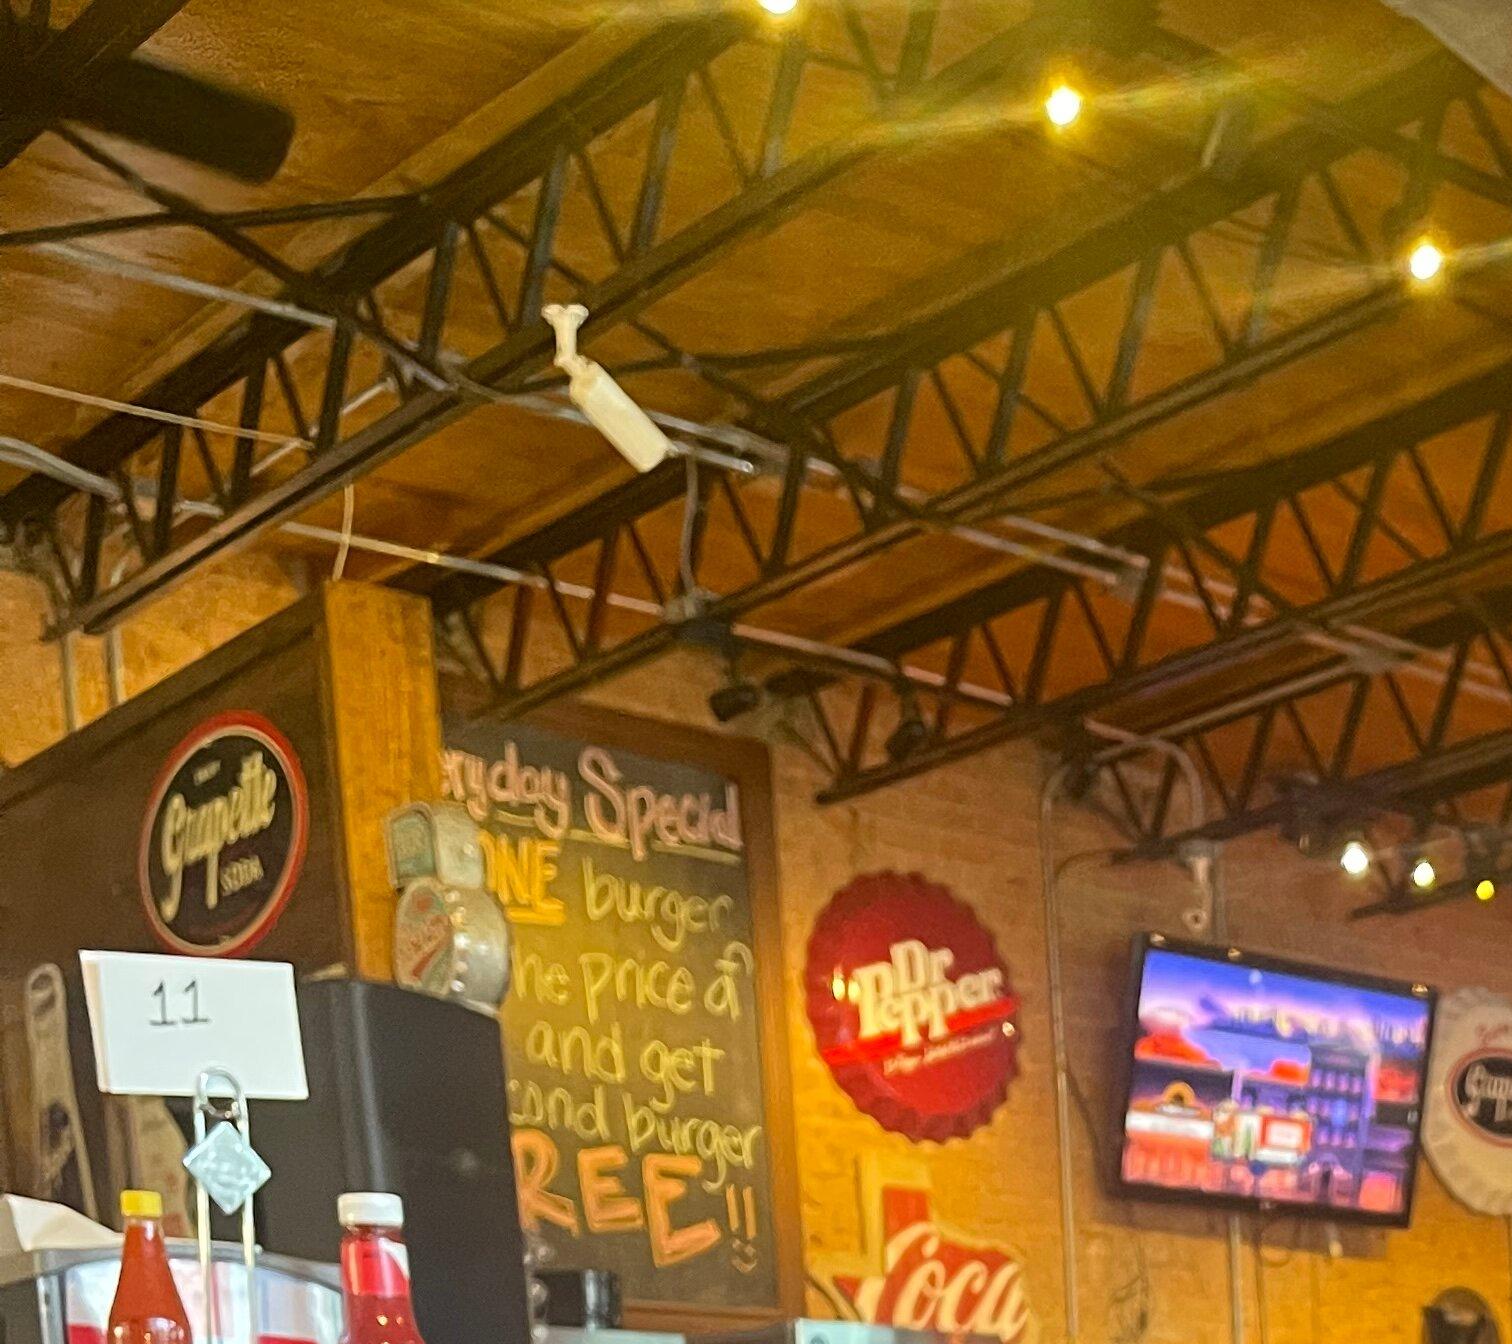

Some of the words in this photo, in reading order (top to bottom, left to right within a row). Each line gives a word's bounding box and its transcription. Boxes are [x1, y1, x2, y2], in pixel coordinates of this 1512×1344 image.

[582, 855, 736, 950] burger
[149, 980, 212, 1026] 11
[511, 944, 570, 1006] he
[577, 952, 696, 1025] price
[851, 961, 1004, 1048] Pepper
[889, 939, 955, 993] Dr
[526, 1020, 626, 1084] and
[639, 1037, 726, 1115] get
[622, 1091, 762, 1195] burger
[511, 1127, 758, 1269] REE!!
